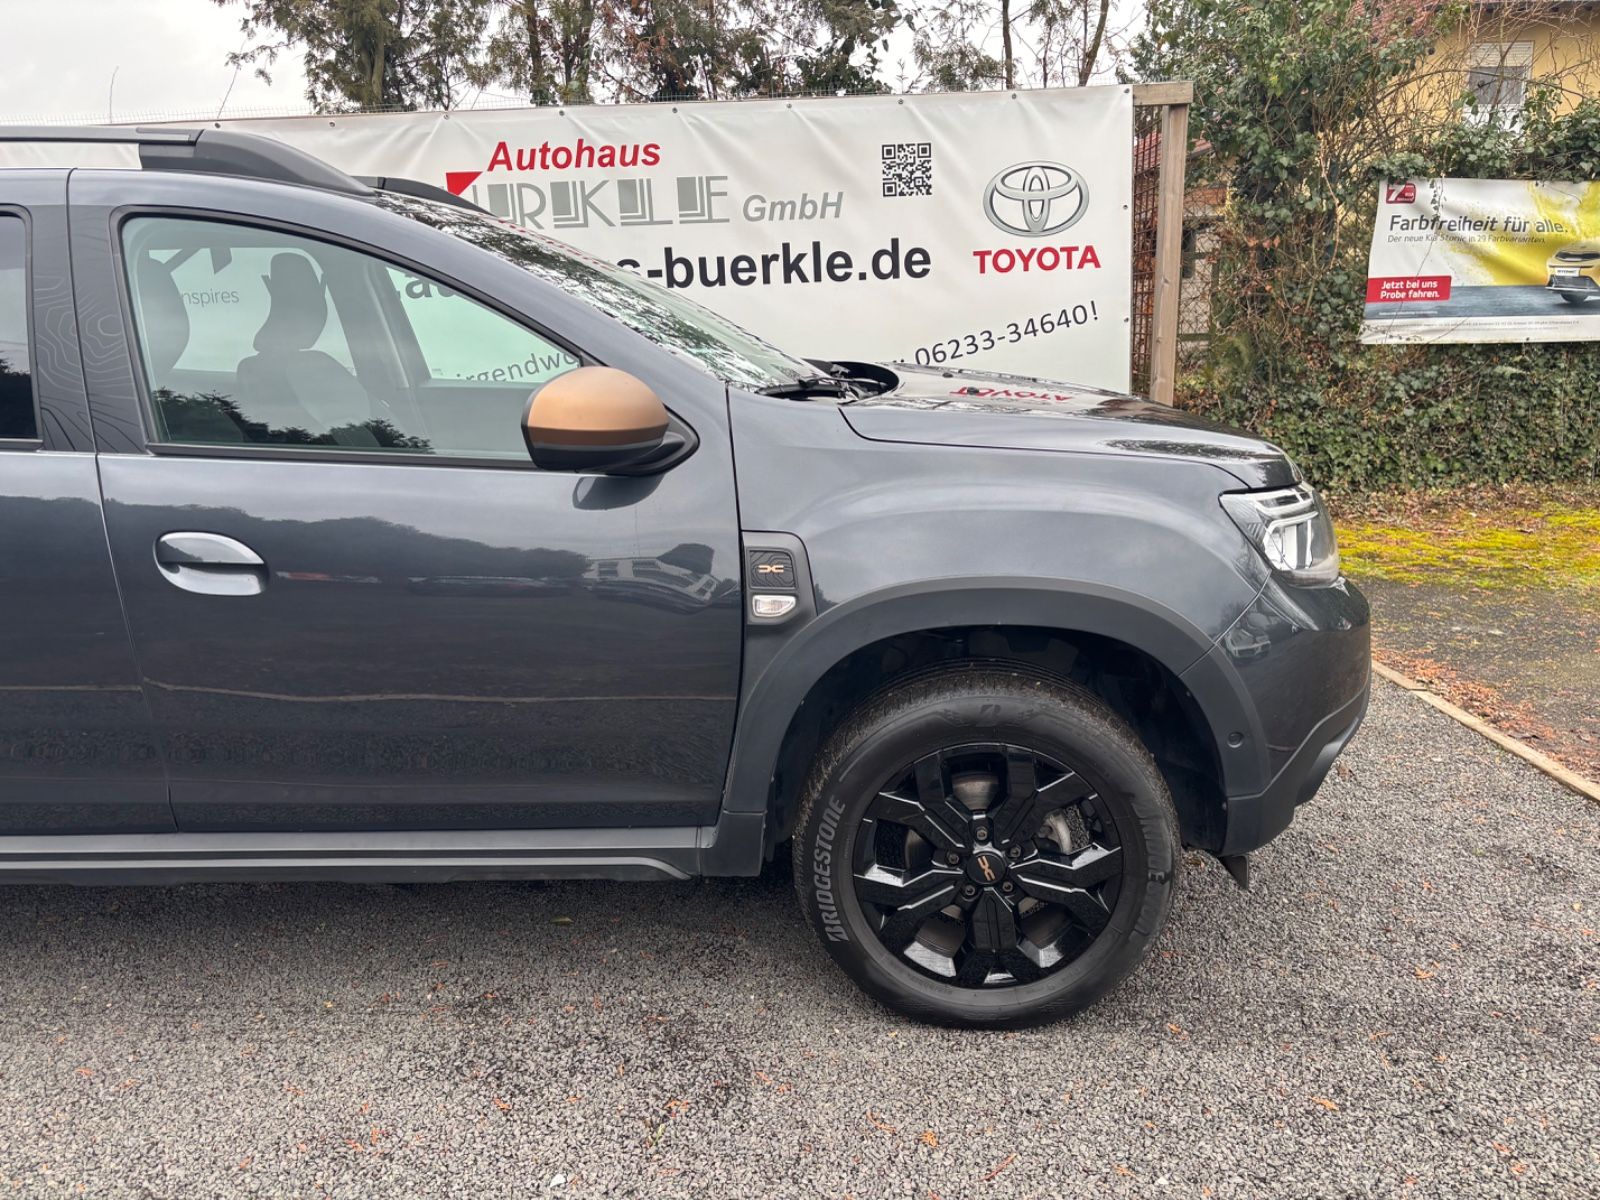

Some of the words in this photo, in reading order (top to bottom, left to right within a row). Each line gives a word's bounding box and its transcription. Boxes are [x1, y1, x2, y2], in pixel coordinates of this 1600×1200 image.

[487, 138, 661, 172] Autohaus
[742, 191, 844, 223] GmbH
[1386, 234, 1402, 243] Der
[1404, 235, 1424, 243] neue
[1389, 214, 1498, 233] Farbfreiheit
[1502, 215, 1530, 234] für
[1535, 218, 1569, 234] alle.
[972, 245, 1102, 275] TOYOTA
[1380, 290, 1407, 300] Probe
[1408, 289, 1440, 300] fahren.
[1381, 281, 1404, 290] Jetzt
[1405, 279, 1420, 289] bei
[1421, 280, 1439, 289] uns
[914, 300, 1099, 366] 06233-34640!
[813, 794, 850, 943] BRIDGESTONE
